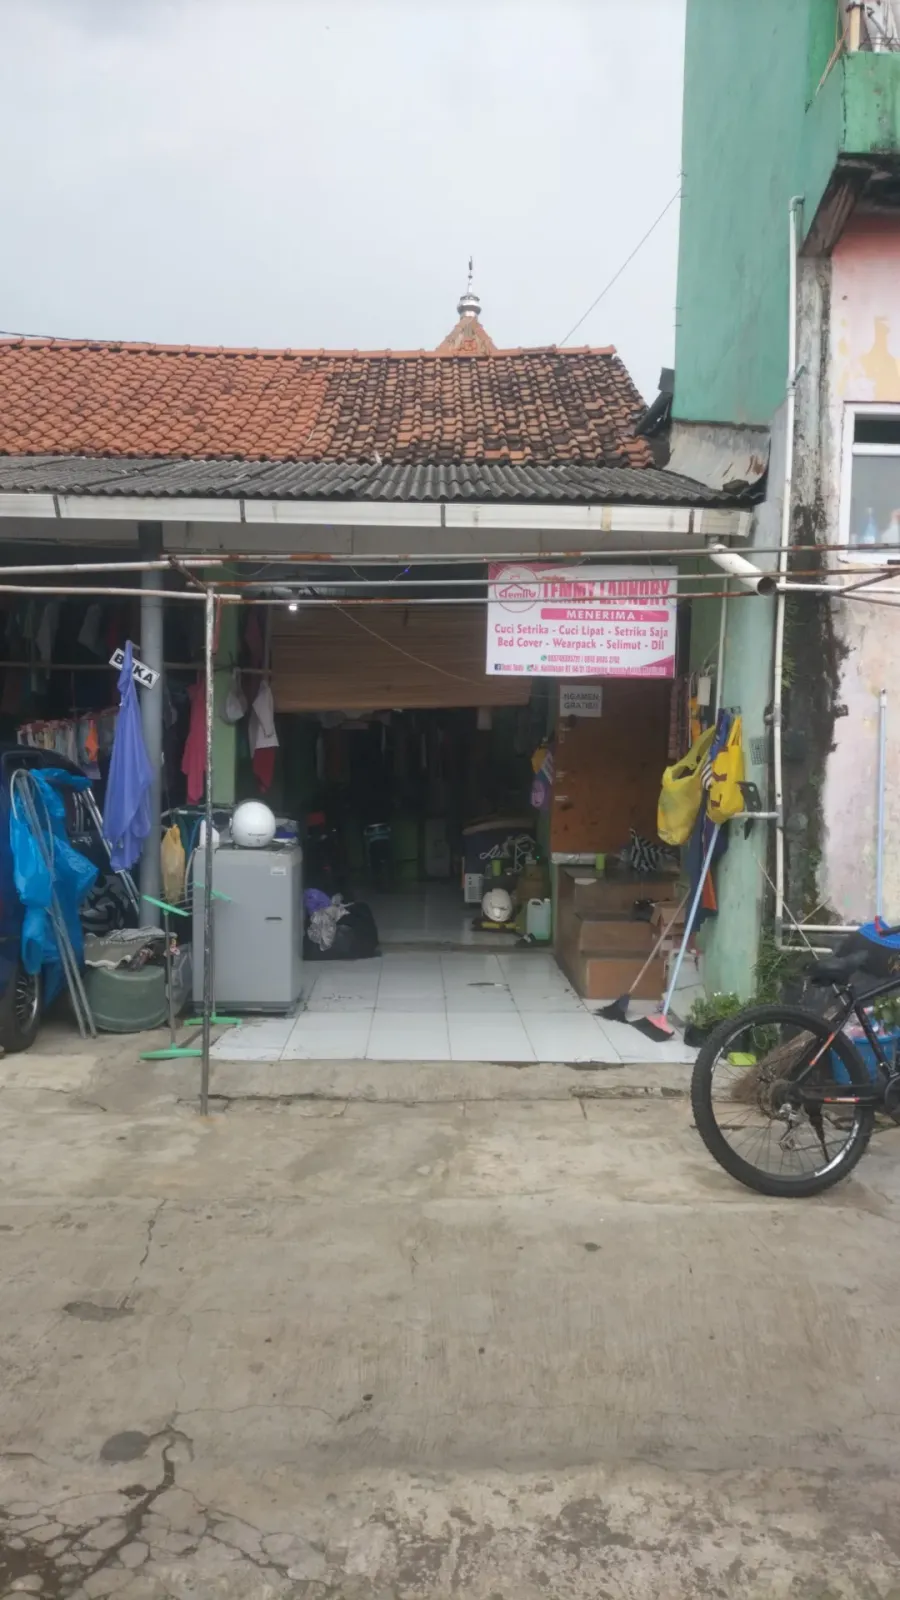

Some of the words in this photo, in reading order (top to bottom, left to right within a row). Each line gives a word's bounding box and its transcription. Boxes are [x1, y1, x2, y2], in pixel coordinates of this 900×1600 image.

[600, 579, 670, 606] LAUNDRY
[566, 609, 636, 620] MENERIMA
[494, 623, 514, 634] Cuci
[517, 623, 549, 635] Setrika
[558, 625, 579, 635] Cuci
[581, 626, 605, 637] Lipat
[615, 626, 647, 637] Setrika
[649, 627, 669, 639] Saja
[497, 637, 514, 647] Bed
[517, 638, 543, 648] Cover
[553, 638, 597, 650] Wearpack
[606, 640, 642, 650] Selimut
[114, 653, 153, 684] BKA
